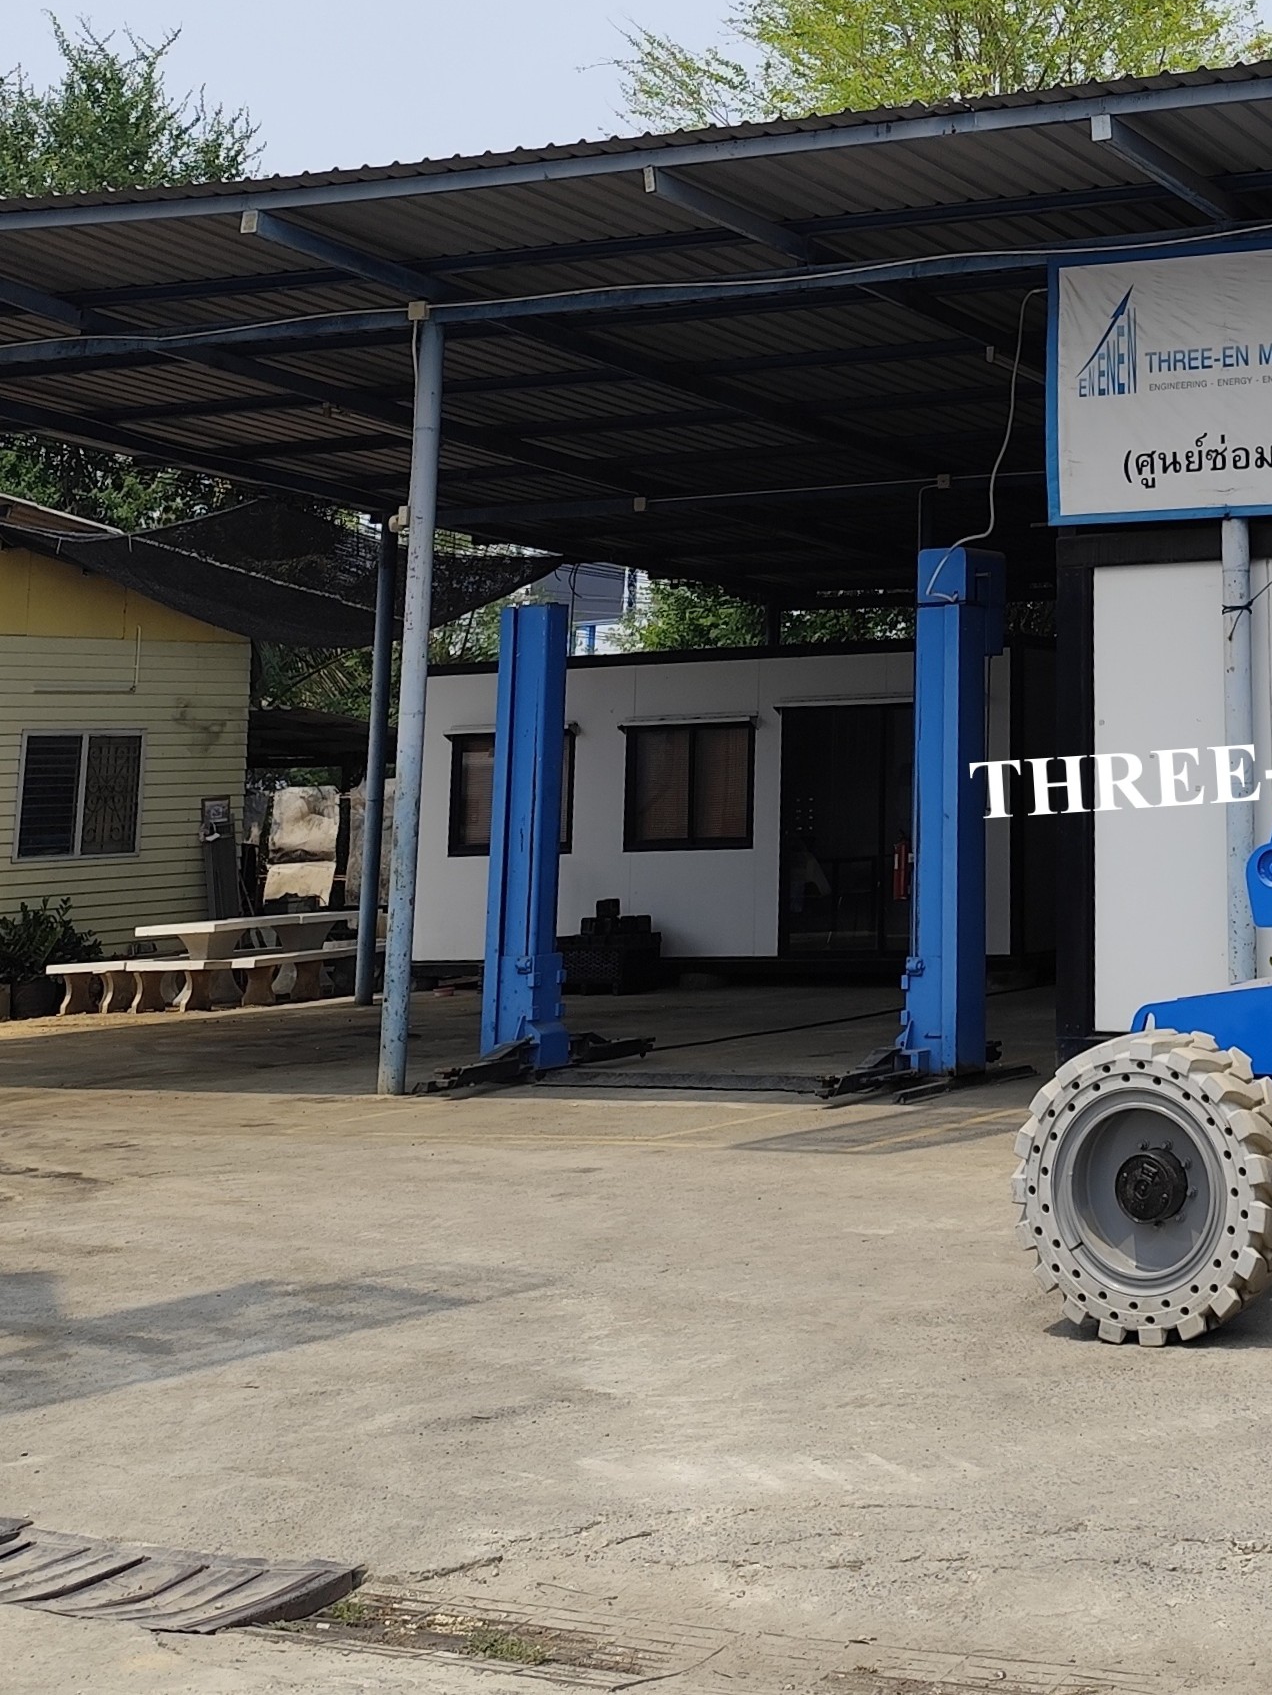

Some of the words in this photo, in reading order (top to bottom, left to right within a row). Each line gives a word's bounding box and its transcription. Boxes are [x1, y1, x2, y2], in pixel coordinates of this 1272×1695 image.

[1145, 344, 1249, 374] THREE-EN
[1149, 379, 1208, 392] ENGINEERING
[1217, 375, 1253, 388] ENERGY
